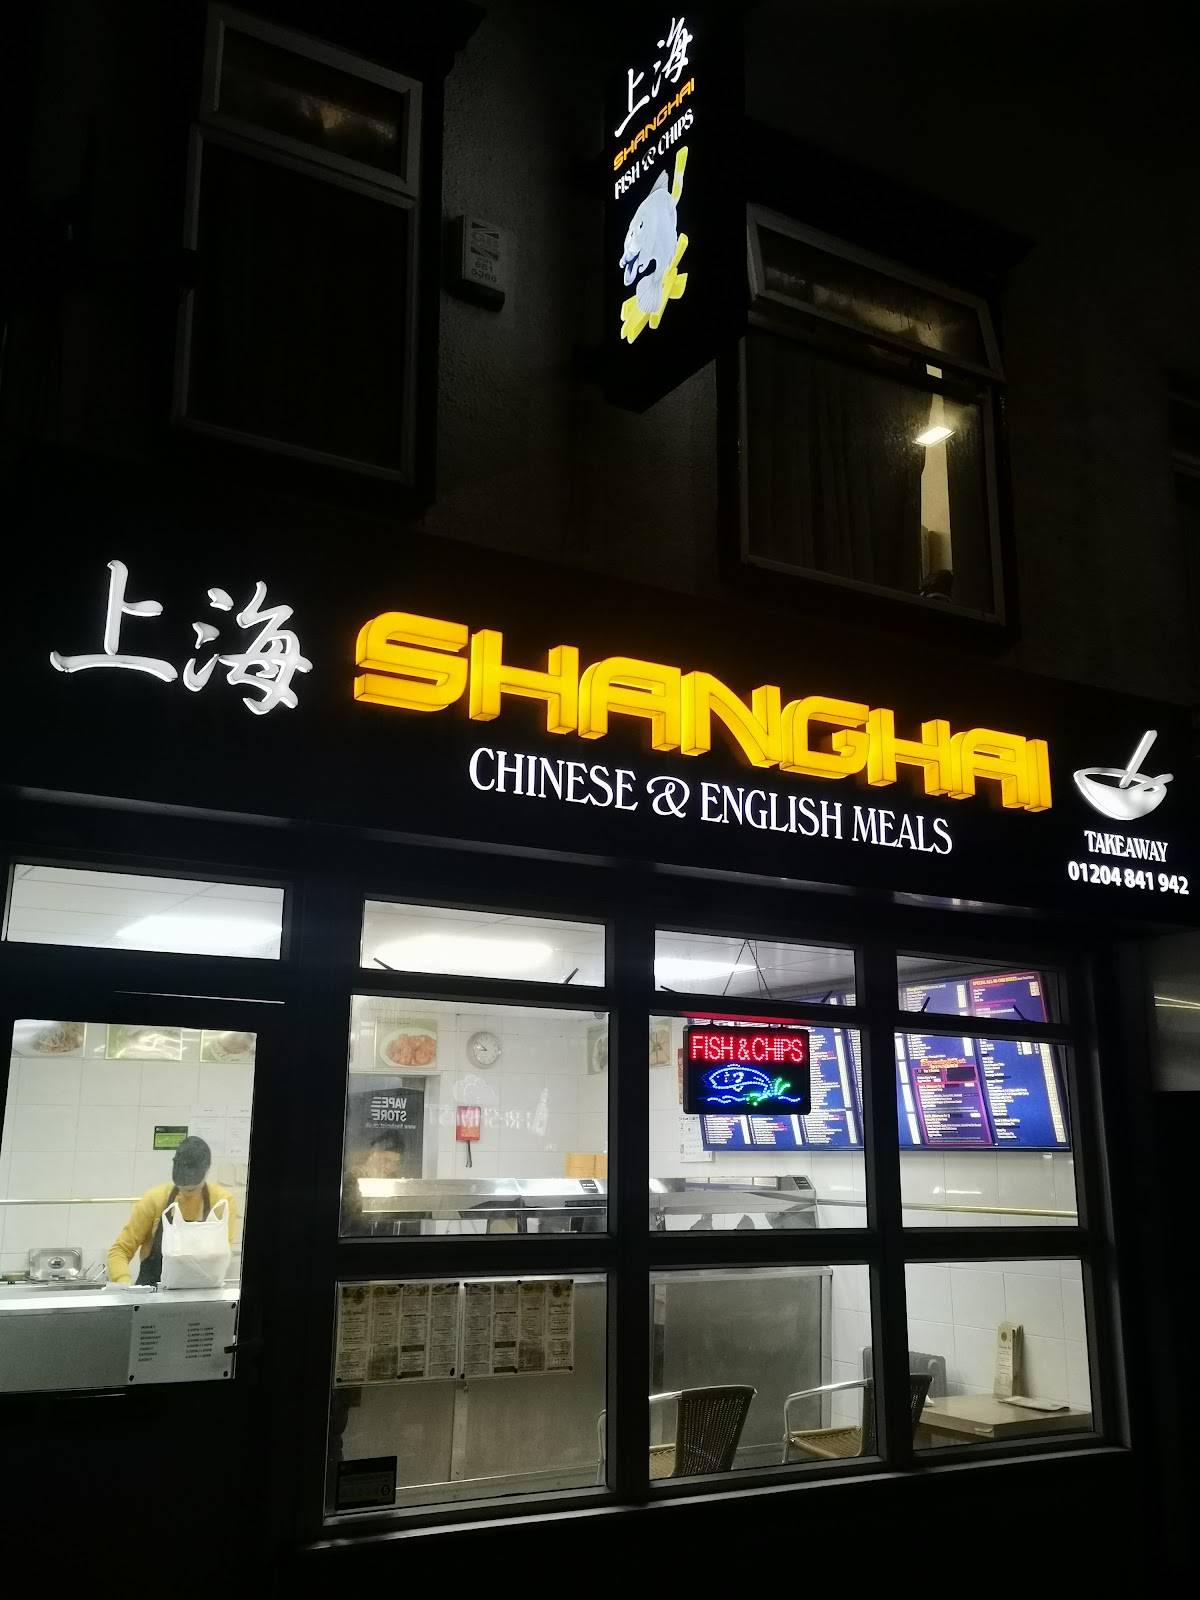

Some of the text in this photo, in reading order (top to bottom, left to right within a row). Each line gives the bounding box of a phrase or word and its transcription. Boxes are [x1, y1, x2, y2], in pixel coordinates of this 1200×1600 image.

[614, 77, 695, 171] SHANGHAI
[615, 17, 694, 138] 上海
[614, 108, 694, 200] FISH & CHIPS
[50, 559, 314, 716] 上海
[353, 611, 1053, 813] SHANGHAI
[468, 747, 953, 855] CHINESE & ENGLISH MEALS
[1084, 829, 1169, 863] TAKEAWAY
[1067, 860, 1190, 895] 01204 841 942
[692, 1035, 803, 1062] FISH & CHIPS
